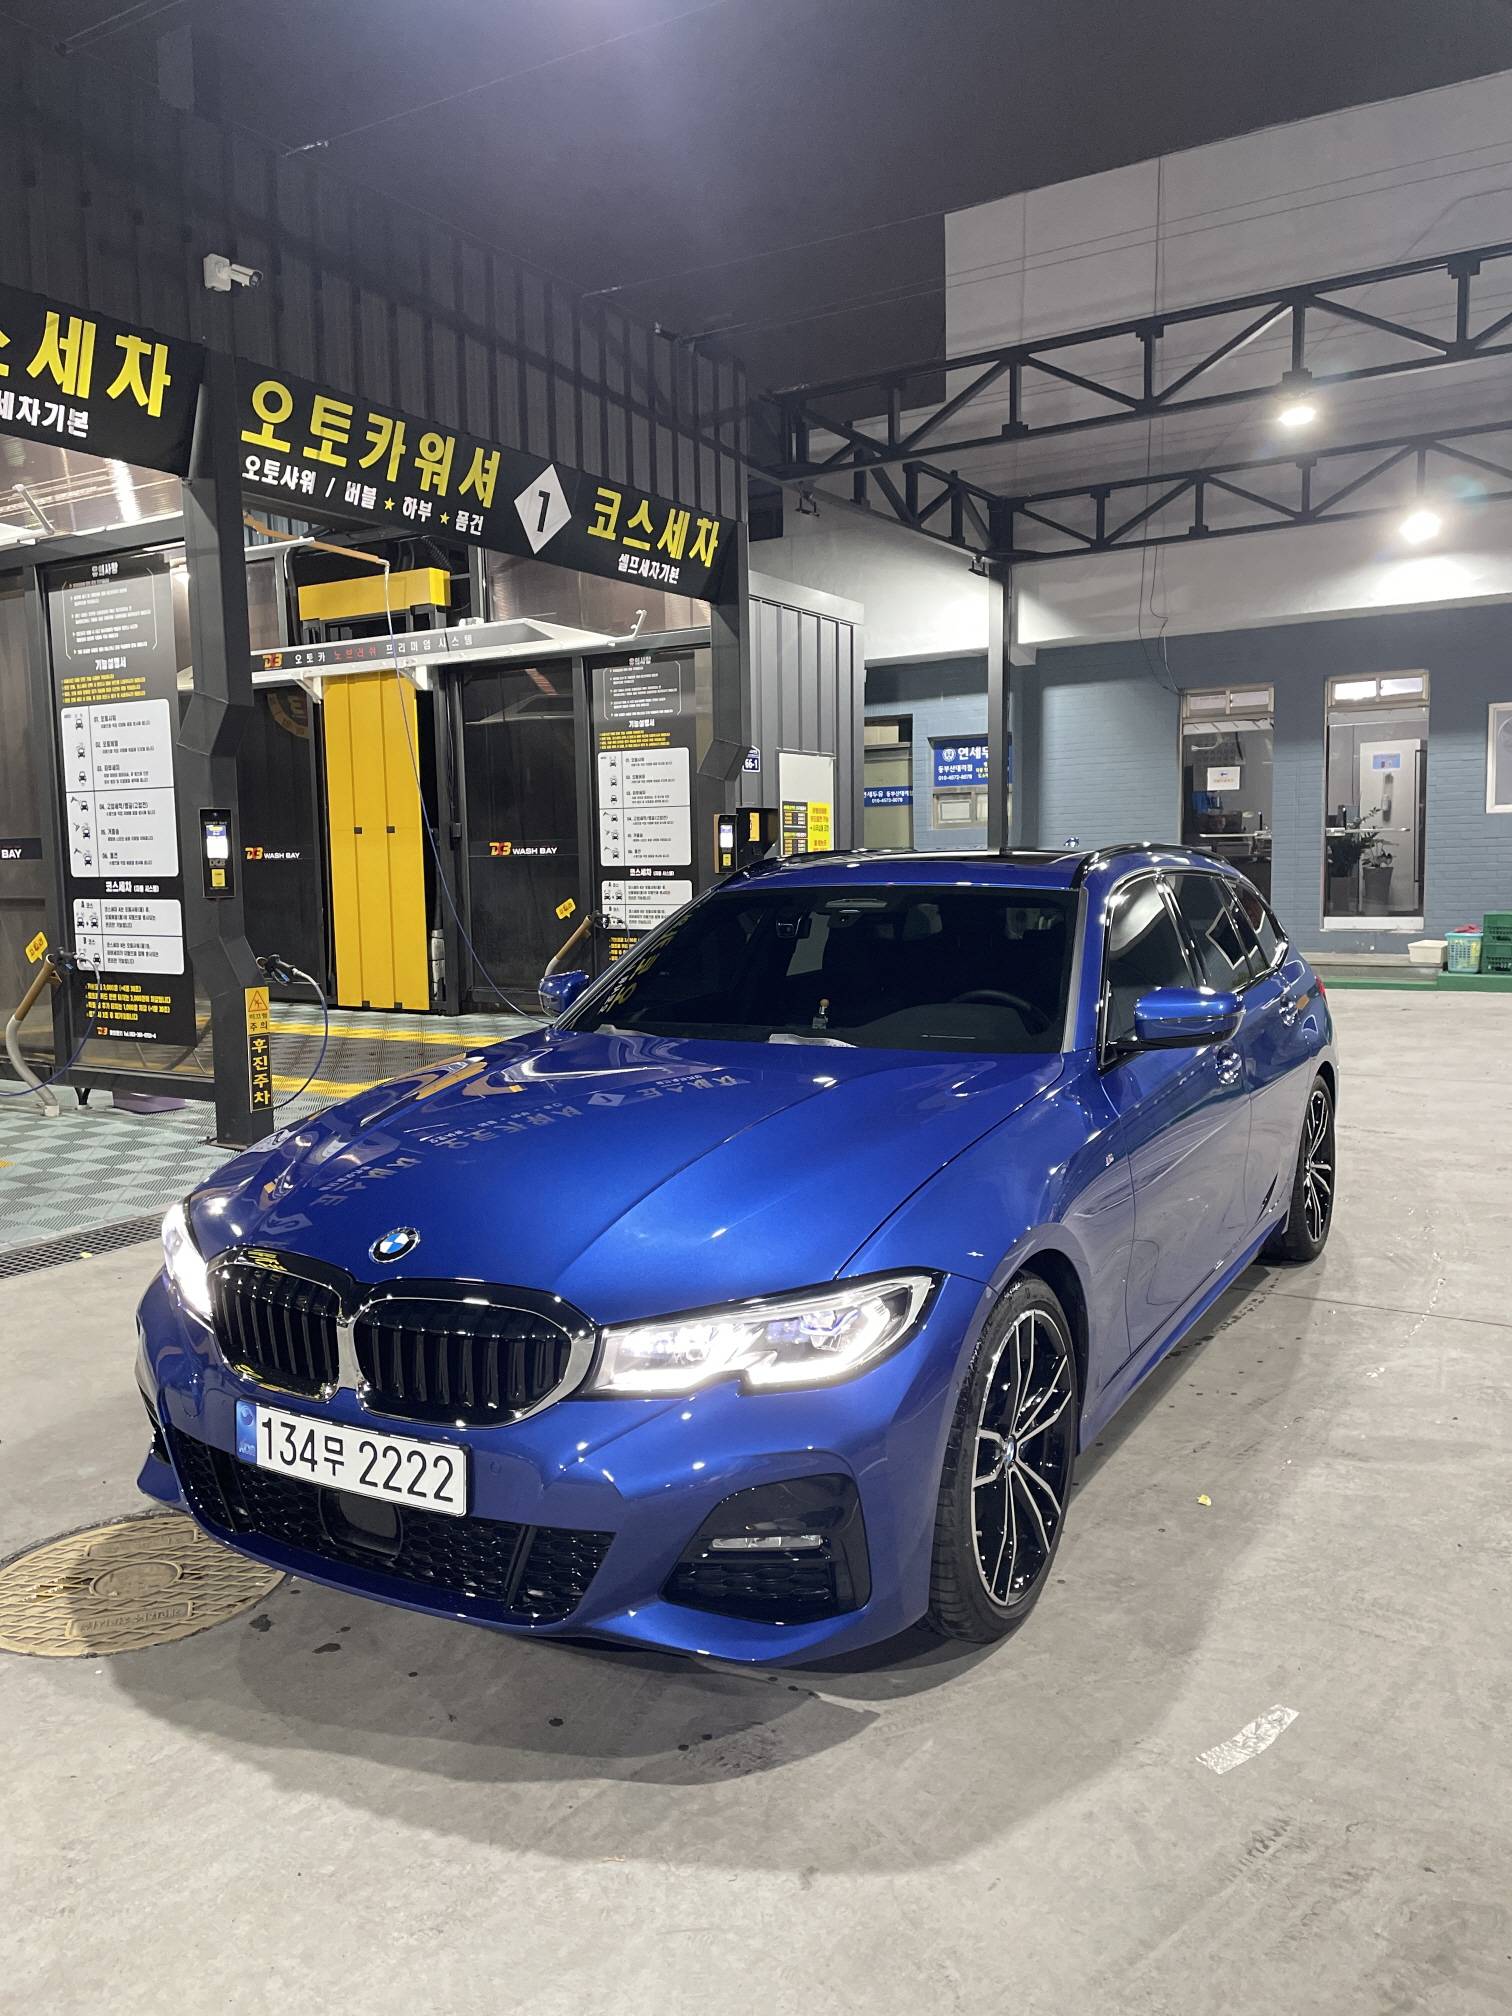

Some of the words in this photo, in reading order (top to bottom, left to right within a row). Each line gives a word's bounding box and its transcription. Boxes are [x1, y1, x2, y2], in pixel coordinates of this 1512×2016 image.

[0, 311, 171, 417] 세차
[241, 380, 500, 509] 오토카워셔
[241, 455, 317, 495] 오토샤워
[344, 480, 377, 510] 버블
[402, 496, 432, 523] 하부
[538, 490, 550, 533] 1
[587, 487, 720, 568] 코스세차
[618, 553, 680, 585] 셀프세차기본
[295, 652, 326, 665] 오토카
[386, 639, 431, 655] 프리미엄
[438, 636, 473, 650] 시스템
[1, 848, 22, 859] BAY
[512, 847, 538, 855] WASH
[539, 847, 558, 855] BAY
[250, 1021, 268, 1031] 주의
[251, 1038, 270, 1105] 후진주차
[262, 1417, 345, 1476] 134무
[358, 1440, 454, 1503] 2222
